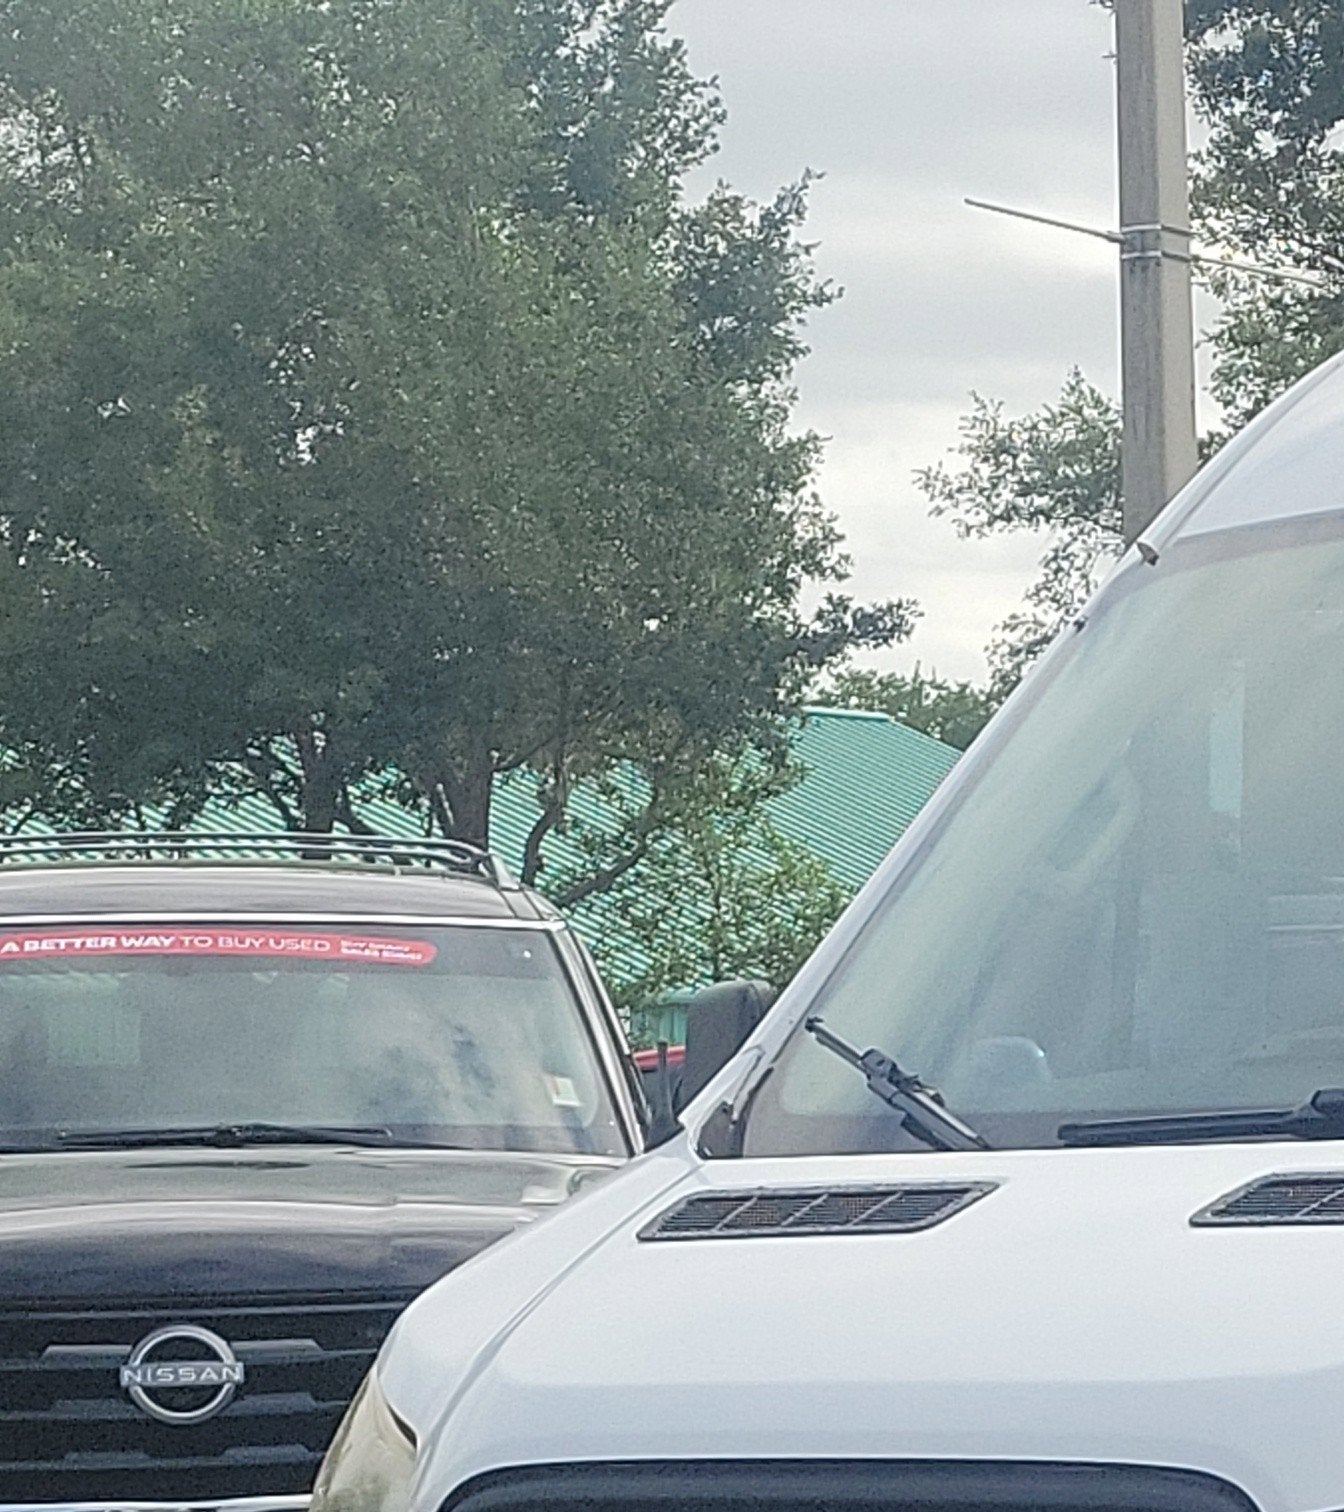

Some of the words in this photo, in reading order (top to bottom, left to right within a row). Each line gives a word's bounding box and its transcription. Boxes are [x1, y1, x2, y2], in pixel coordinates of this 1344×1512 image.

[0, 941, 20, 953] A
[24, 936, 117, 952] BETTER
[120, 935, 176, 948] WAY
[179, 936, 213, 948] TO
[218, 936, 266, 949] BUY
[268, 937, 331, 952] USED
[123, 1366, 240, 1383] NISSAN
